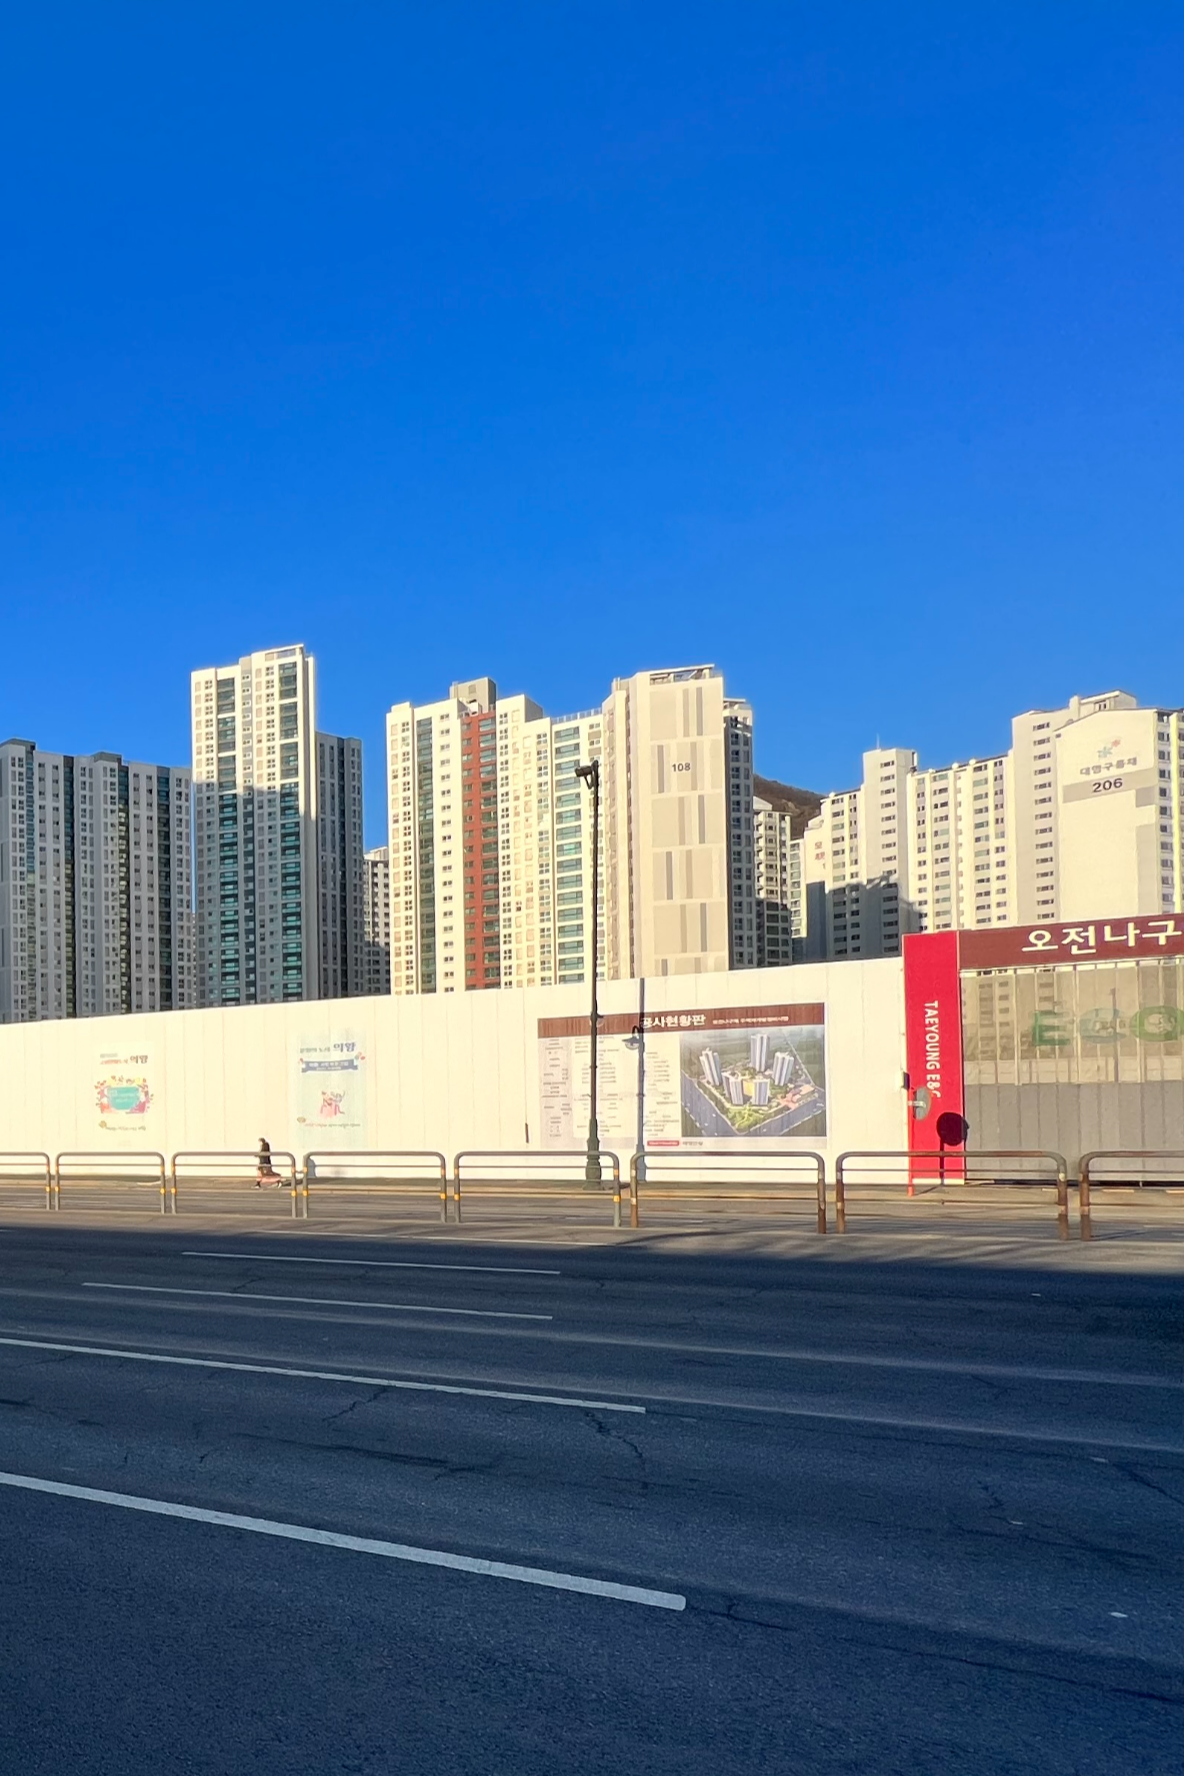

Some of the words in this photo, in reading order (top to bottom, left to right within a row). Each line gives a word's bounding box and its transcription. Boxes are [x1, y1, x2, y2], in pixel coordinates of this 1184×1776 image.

[672, 762, 691, 772] 108
[1092, 778, 1123, 793] 206
[924, 1000, 941, 1071] TAEYOUNG
